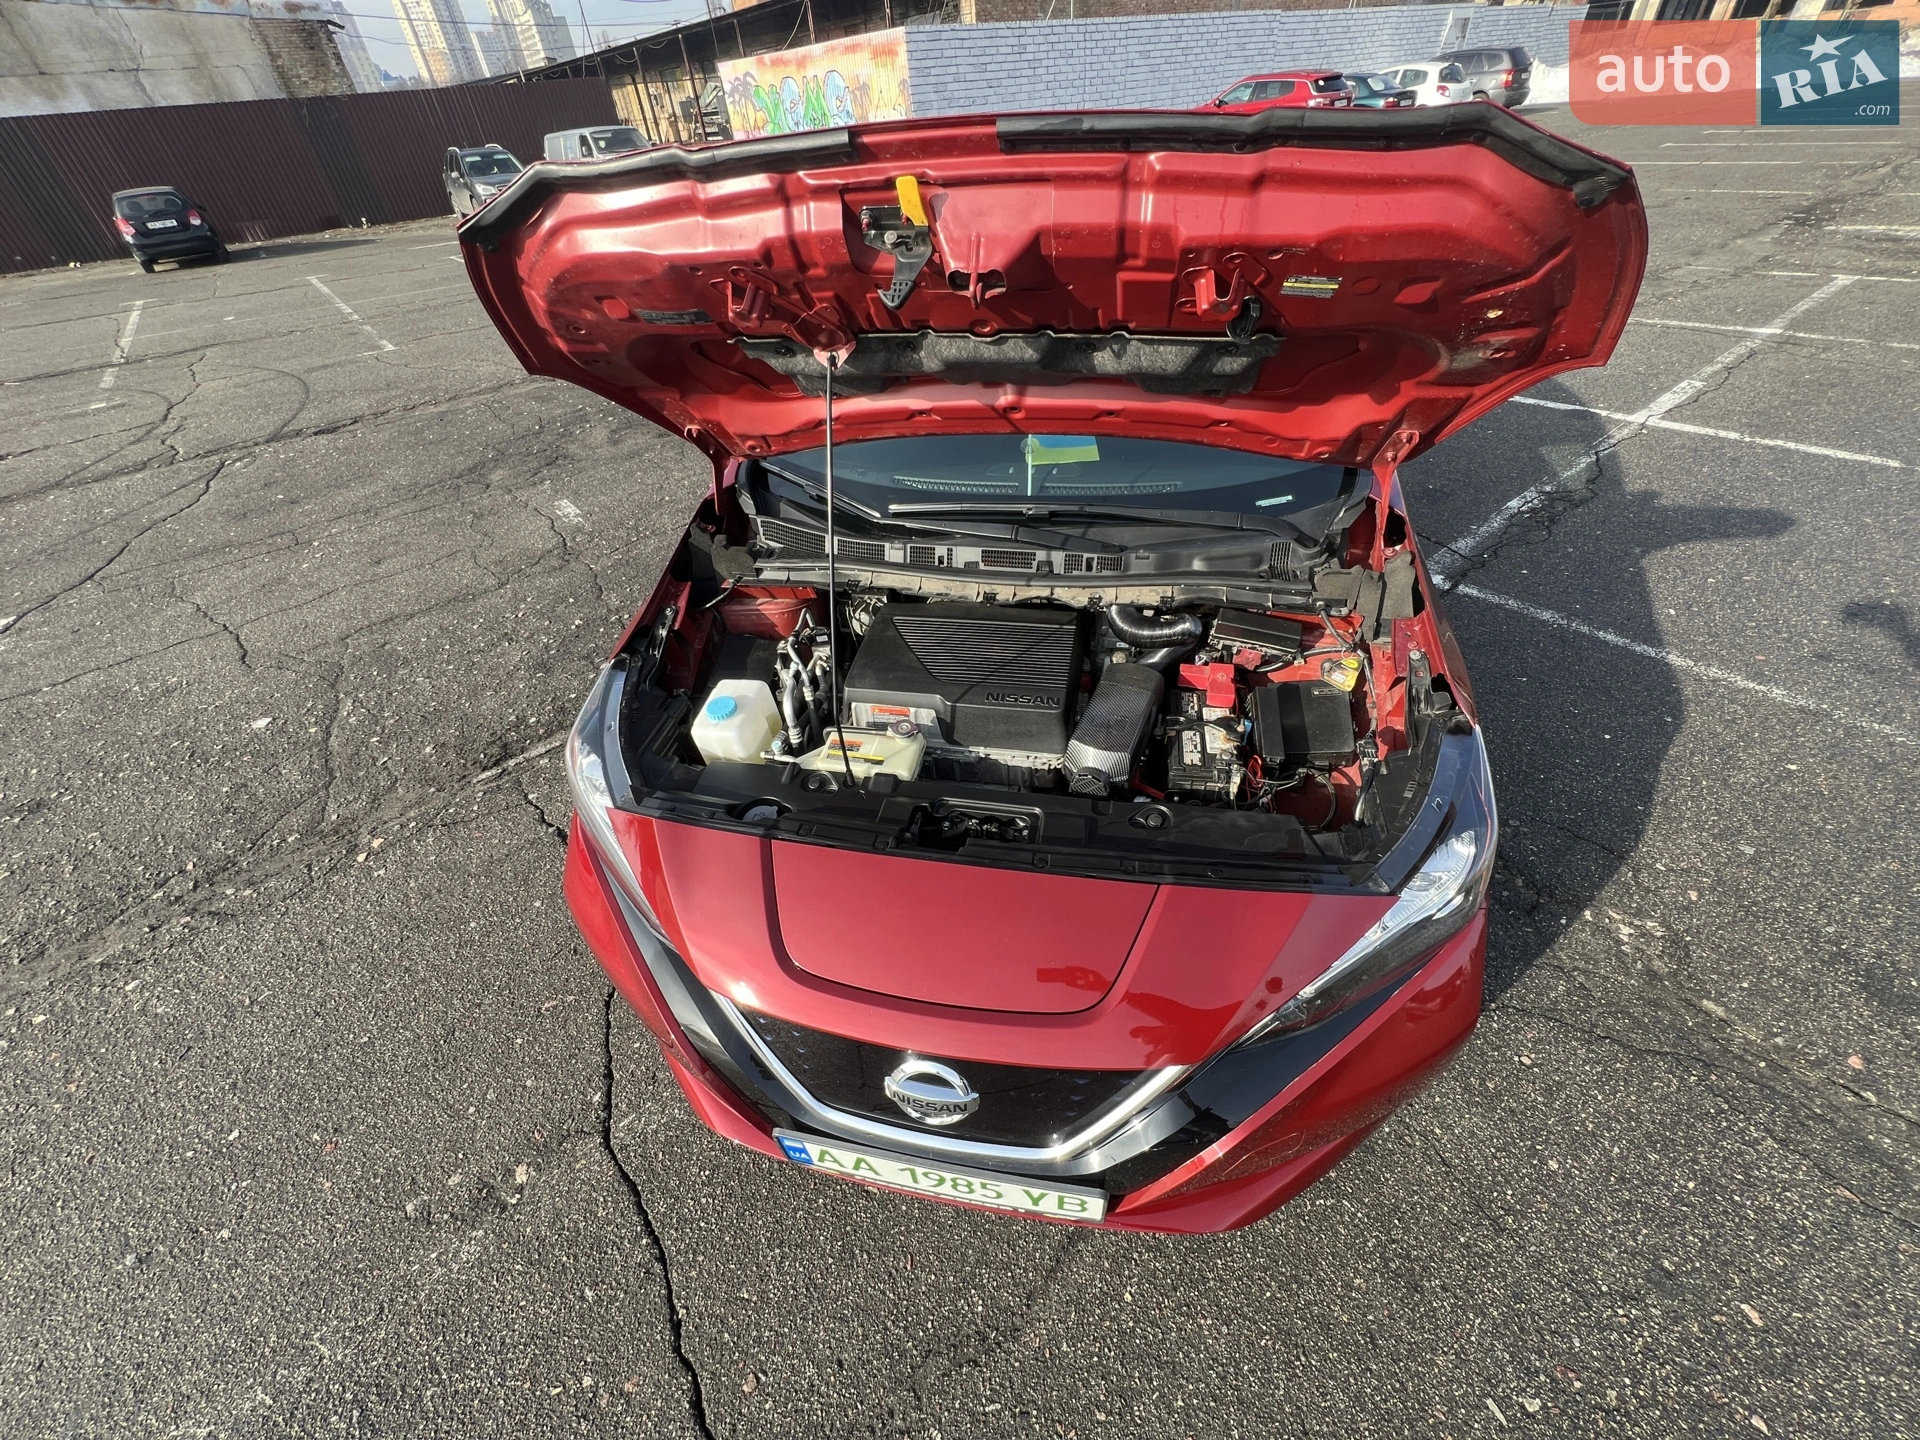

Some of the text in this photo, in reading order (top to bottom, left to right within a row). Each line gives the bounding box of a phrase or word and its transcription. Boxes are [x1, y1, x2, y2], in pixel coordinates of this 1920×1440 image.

[985, 692, 1061, 707] NISSAN
[893, 1091, 968, 1113] NISSAN
[789, 1150, 811, 1160] UA
[817, 1148, 1089, 1213] AA 1985 YB
